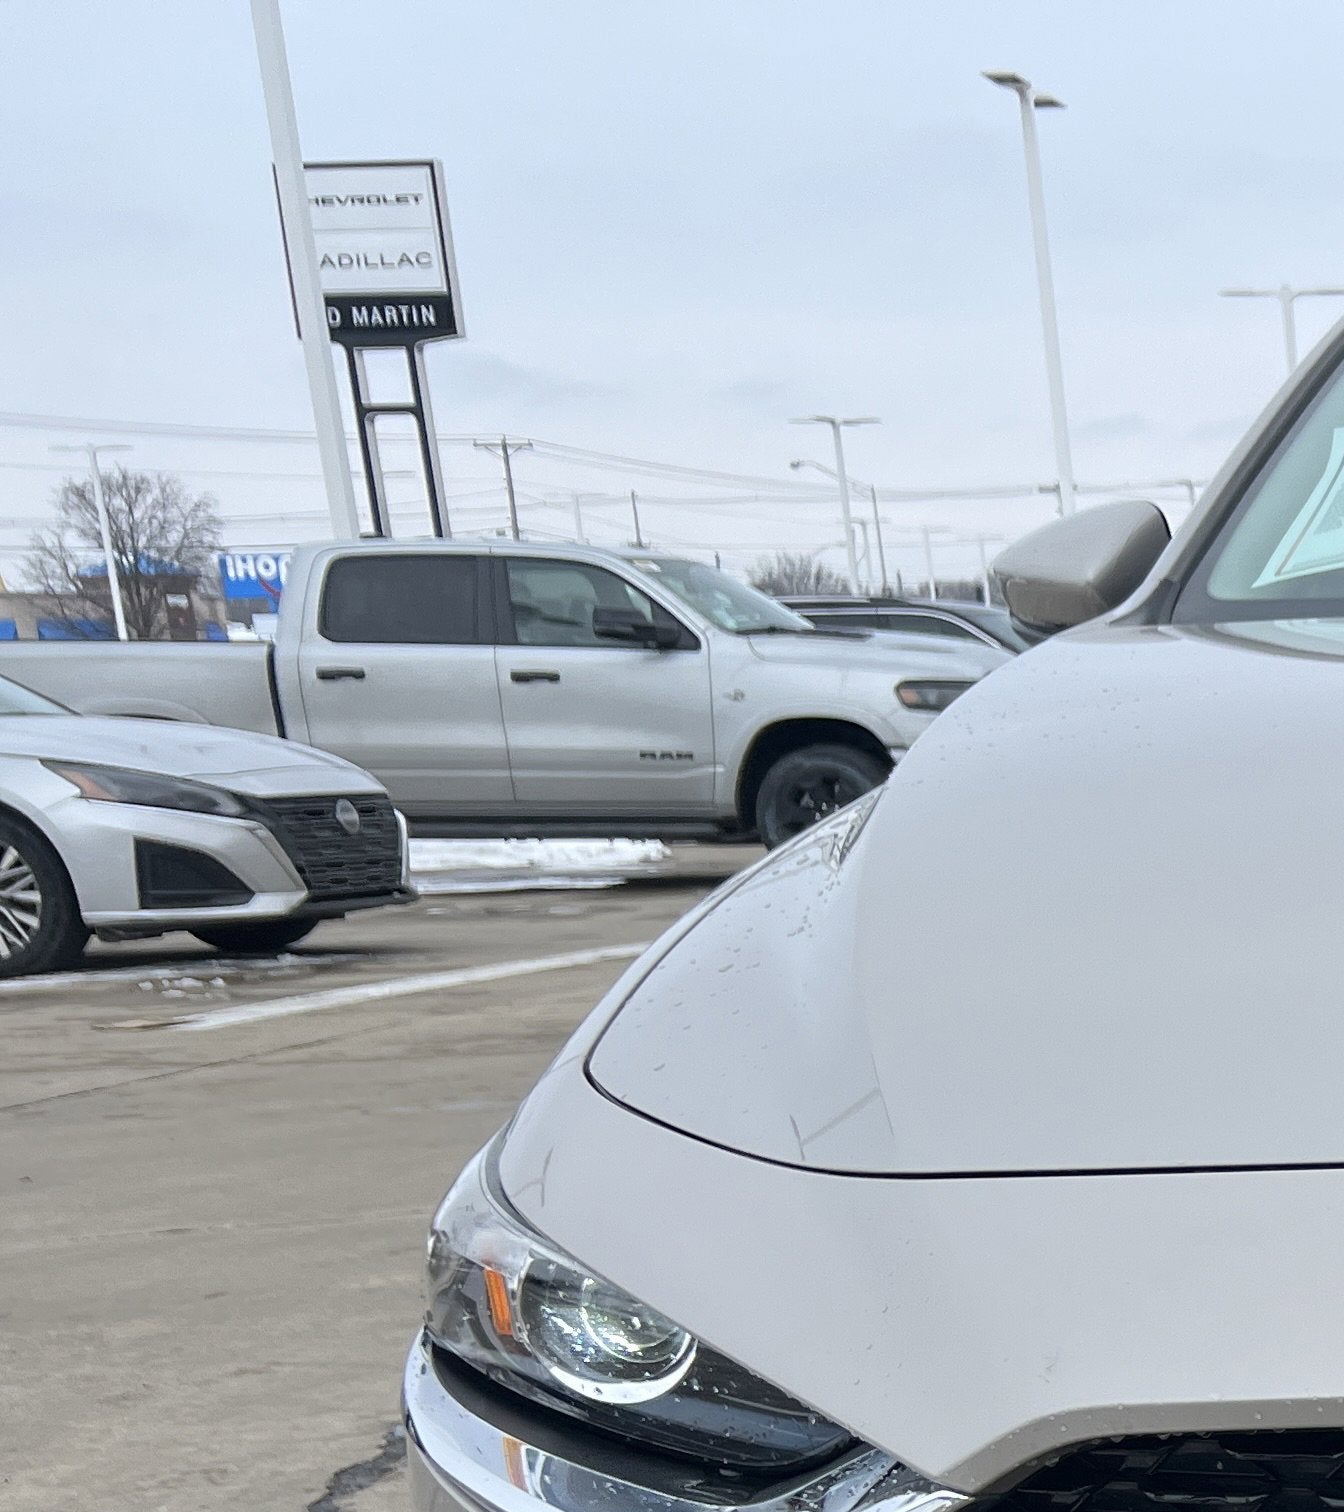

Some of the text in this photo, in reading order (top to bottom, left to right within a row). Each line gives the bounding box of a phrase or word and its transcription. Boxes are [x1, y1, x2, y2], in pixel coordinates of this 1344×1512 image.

[308, 193, 423, 207] HEVROLET
[319, 251, 433, 270] ADILLAC
[352, 304, 437, 327] MARTIN
